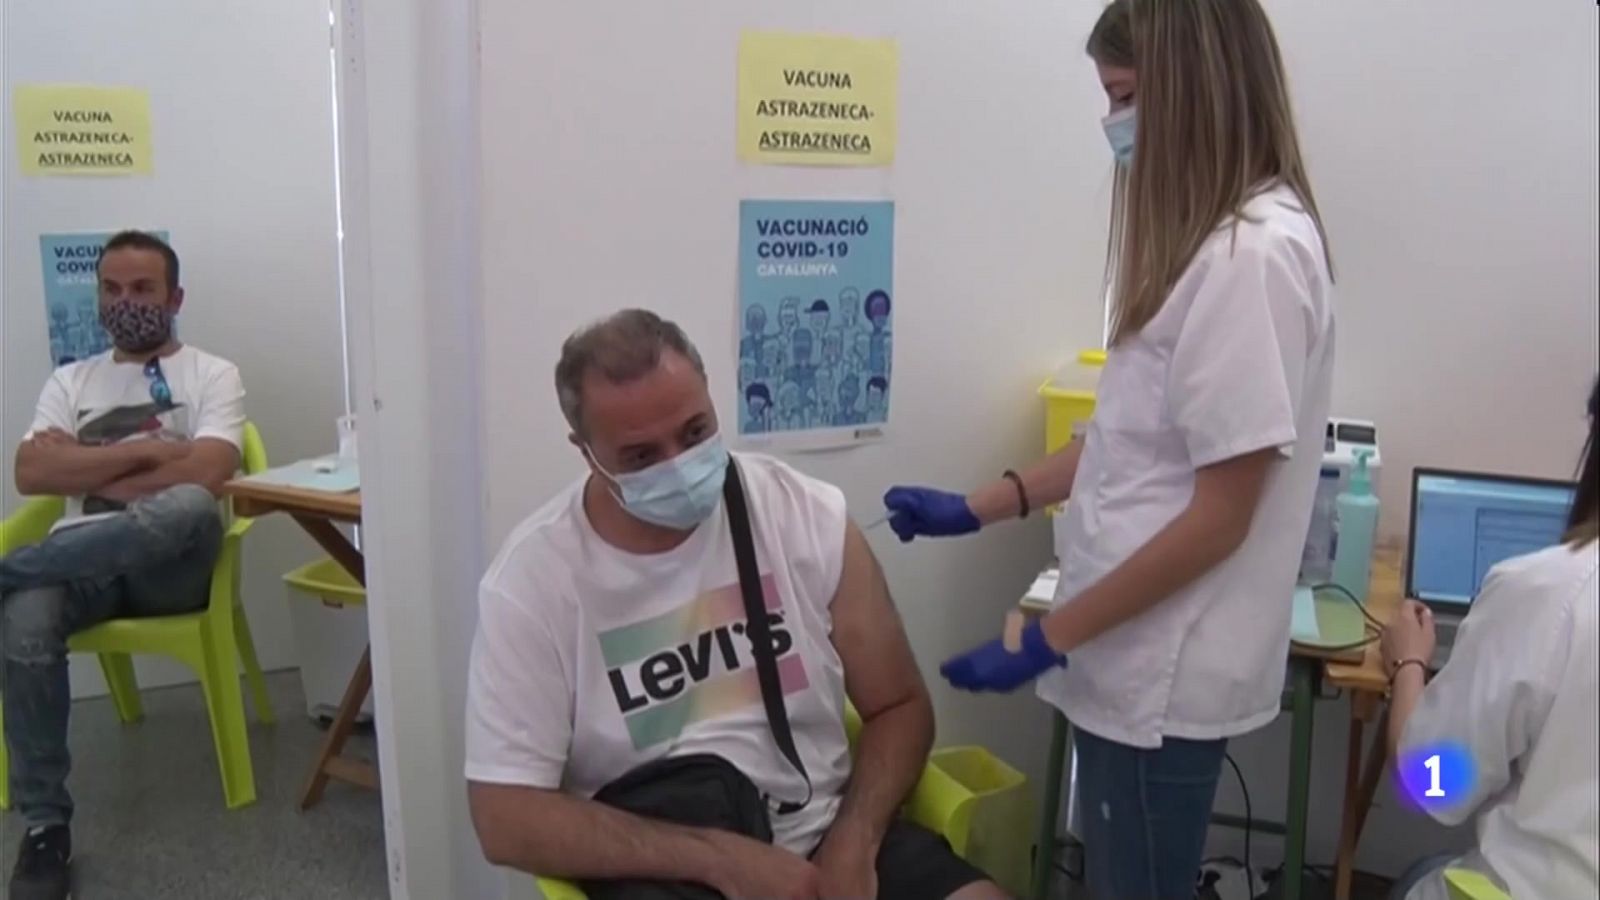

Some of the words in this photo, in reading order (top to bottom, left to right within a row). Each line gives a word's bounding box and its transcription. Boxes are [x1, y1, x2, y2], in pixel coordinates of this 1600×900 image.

[784, 69, 852, 89] VACUNA
[54, 110, 113, 123] VACUNA
[756, 99, 875, 121] ASTRAZENECA-
[34, 131, 134, 144] ASTRAZENECA-
[758, 132, 872, 153] ASTRAZENECA
[38, 152, 134, 166] ASTRAZENECA
[757, 215, 869, 236] VACUNACIÓ
[757, 241, 848, 258] COVID-19
[757, 263, 838, 277] CATALUNYA
